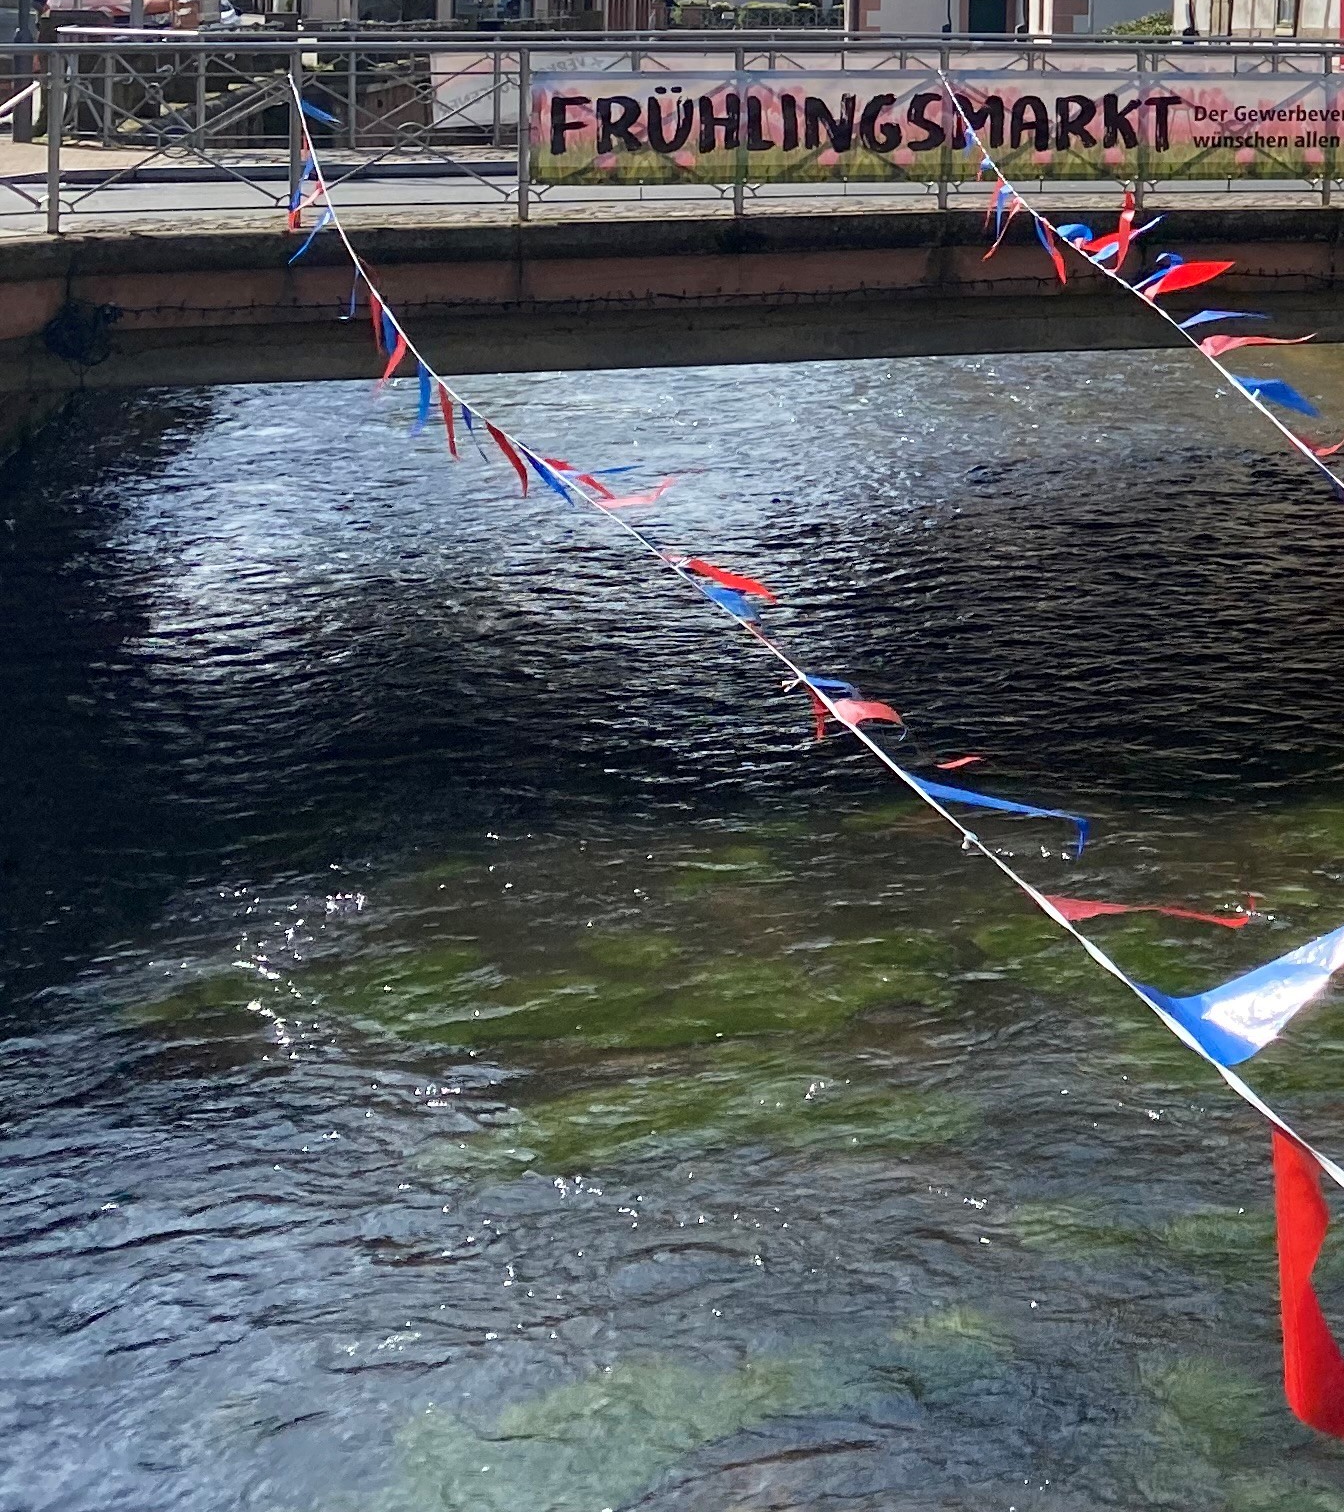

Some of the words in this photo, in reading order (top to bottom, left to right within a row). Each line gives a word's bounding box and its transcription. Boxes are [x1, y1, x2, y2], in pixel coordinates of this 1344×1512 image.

[549, 85, 1183, 155] FRÜHLINGSMARKT
[1194, 105, 1227, 122] Der
[1193, 131, 1288, 148] wünschen
[1294, 131, 1340, 148] allen
